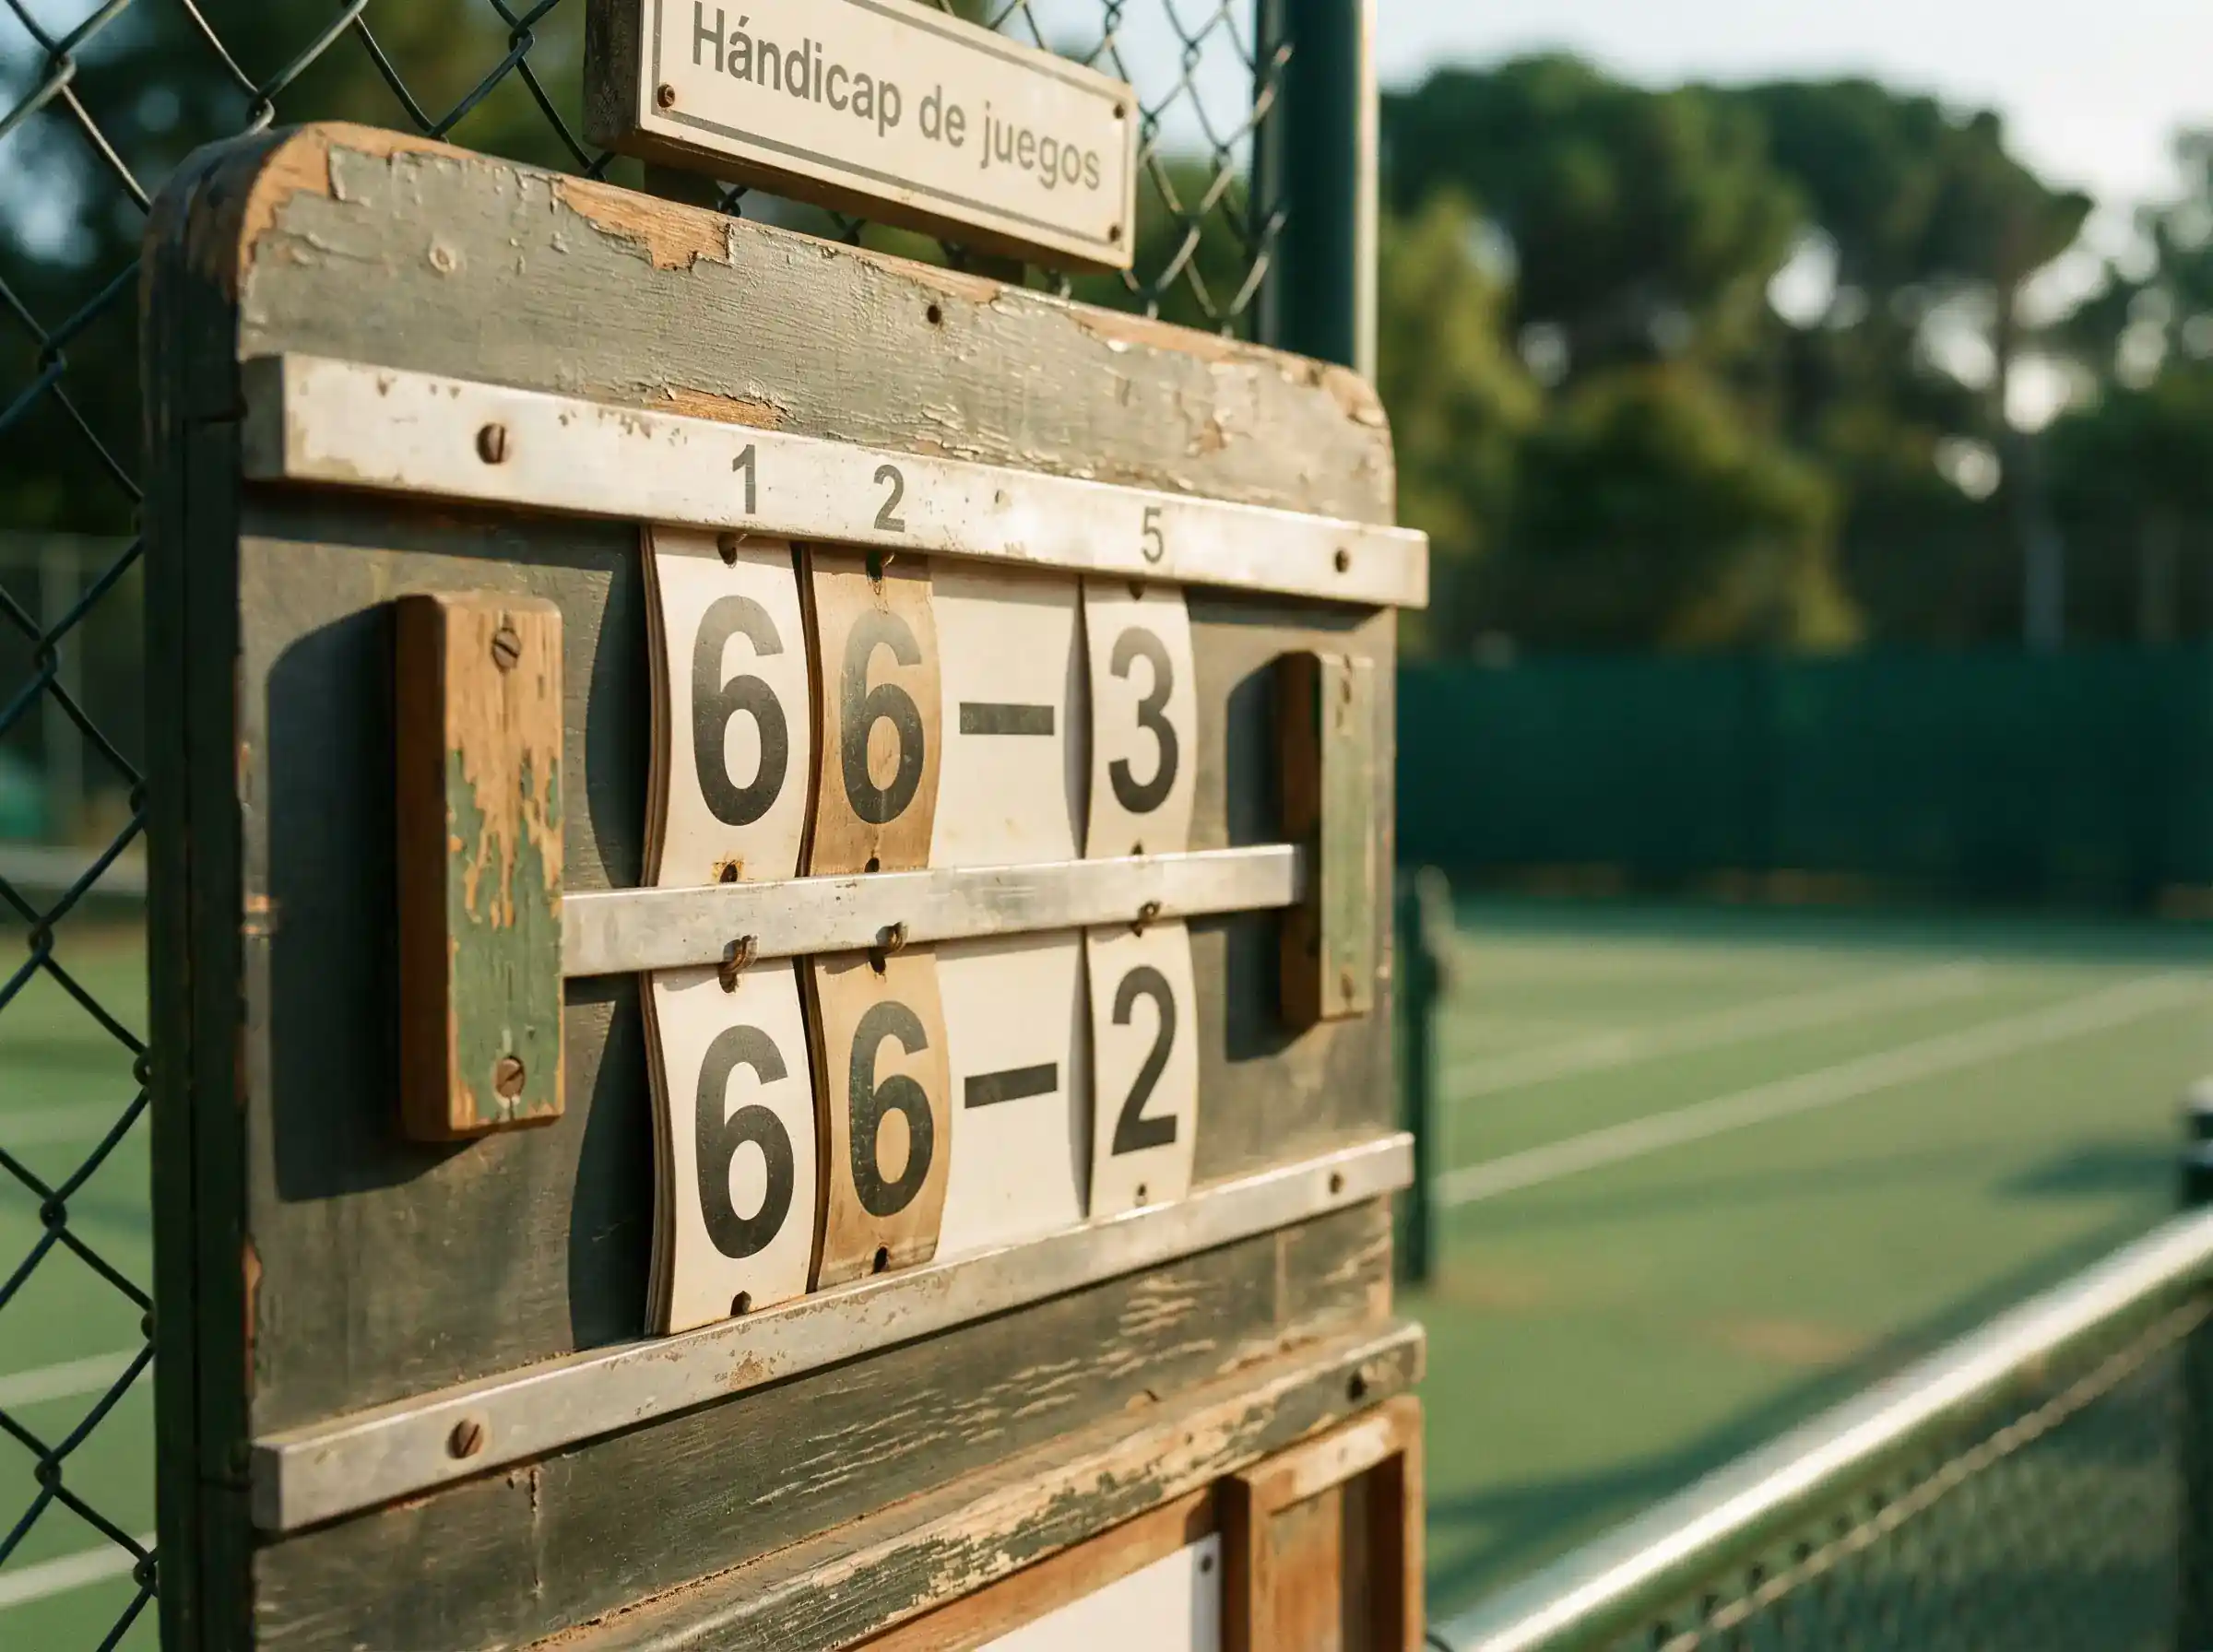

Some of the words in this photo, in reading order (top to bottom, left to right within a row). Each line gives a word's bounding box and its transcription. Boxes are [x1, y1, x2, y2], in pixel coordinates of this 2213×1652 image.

[692, 1, 902, 136] Hándicap
[919, 86, 966, 148] de
[979, 100, 1102, 191] juegos
[732, 443, 756, 514] 1
[872, 464, 905, 533] 2
[1141, 506, 1165, 565] 5
